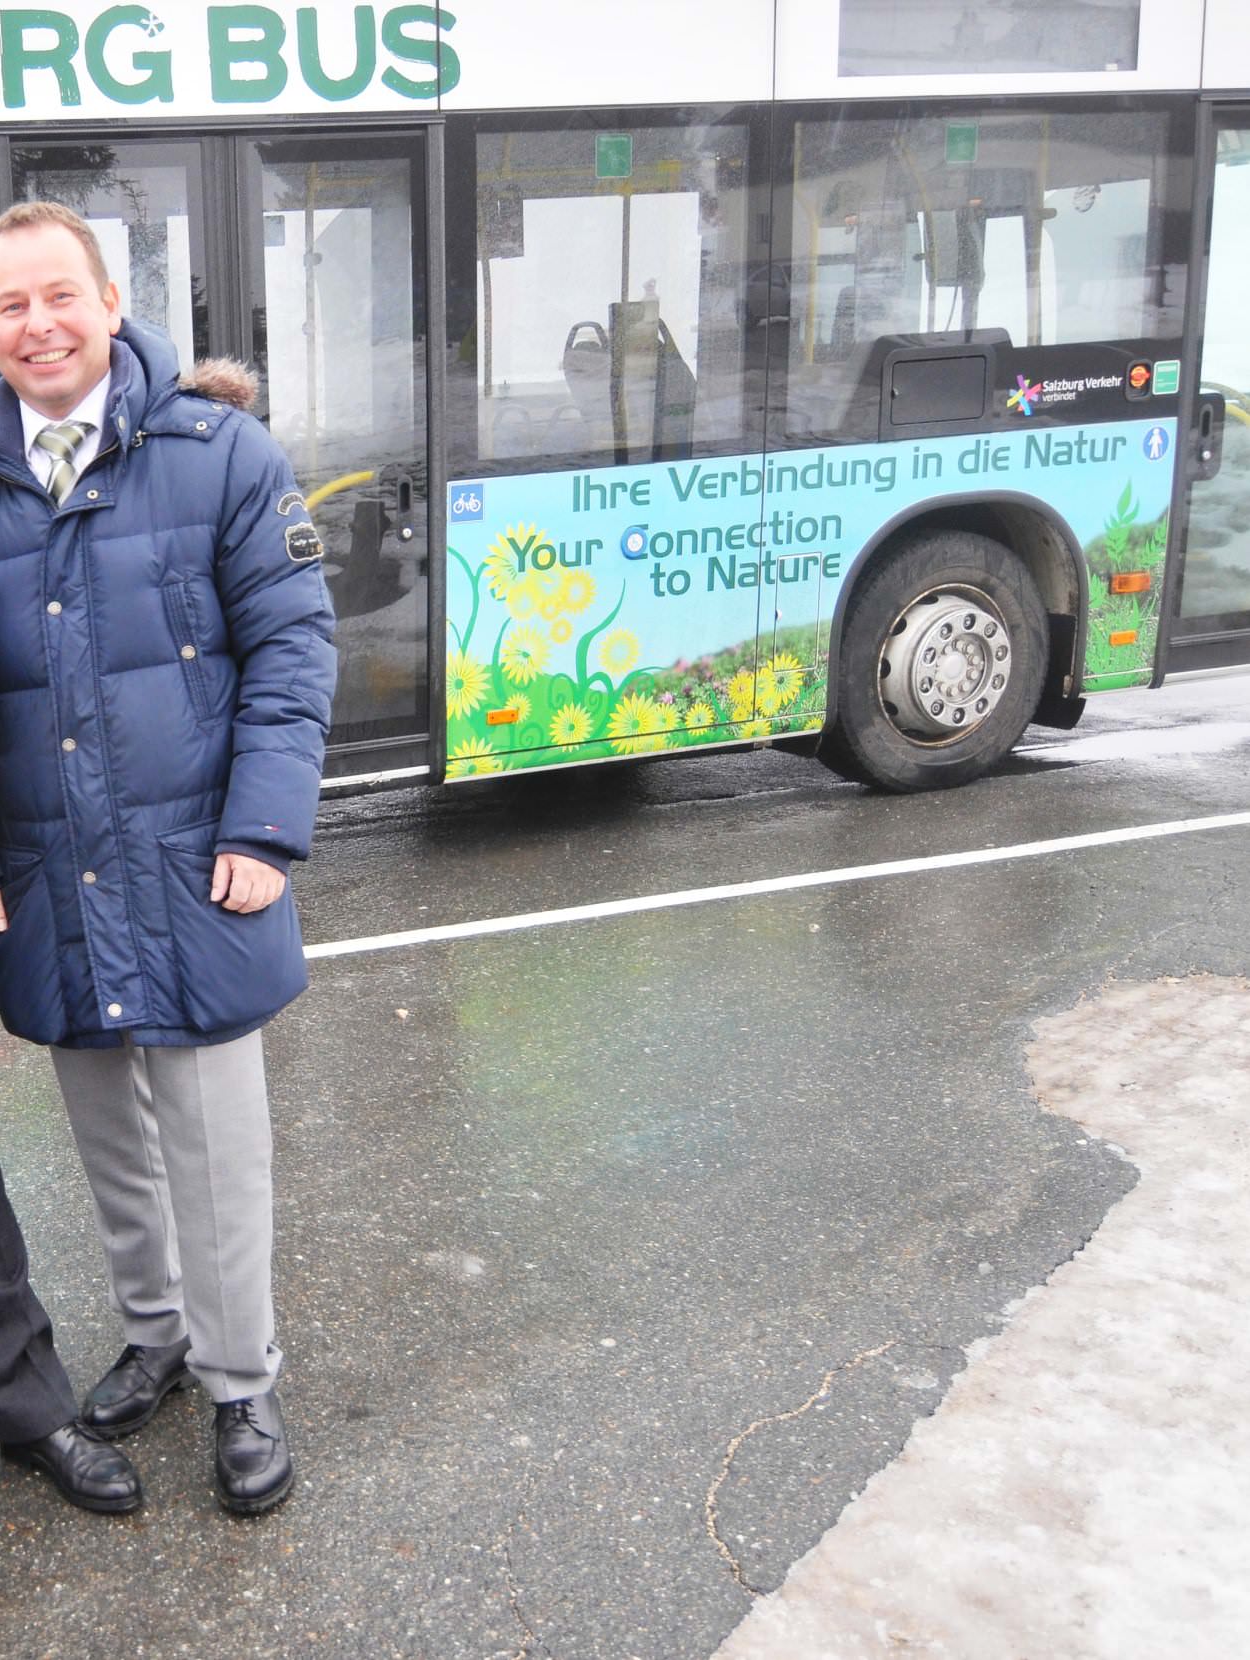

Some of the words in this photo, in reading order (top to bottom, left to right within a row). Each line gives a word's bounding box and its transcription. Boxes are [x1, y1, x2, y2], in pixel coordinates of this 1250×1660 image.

[207, 4, 461, 103] BUS
[1042, 378, 1084, 392] Salzburg
[1085, 376, 1123, 389] Verkehr
[1042, 391, 1076, 402] verbindet
[573, 474, 651, 513] Ihre
[668, 452, 897, 502] Verbindung
[912, 446, 943, 481] in
[957, 439, 1011, 475] die
[1024, 430, 1127, 469] Natur
[507, 535, 603, 573] Your
[650, 562, 691, 597] to
[707, 550, 842, 592] Nature
